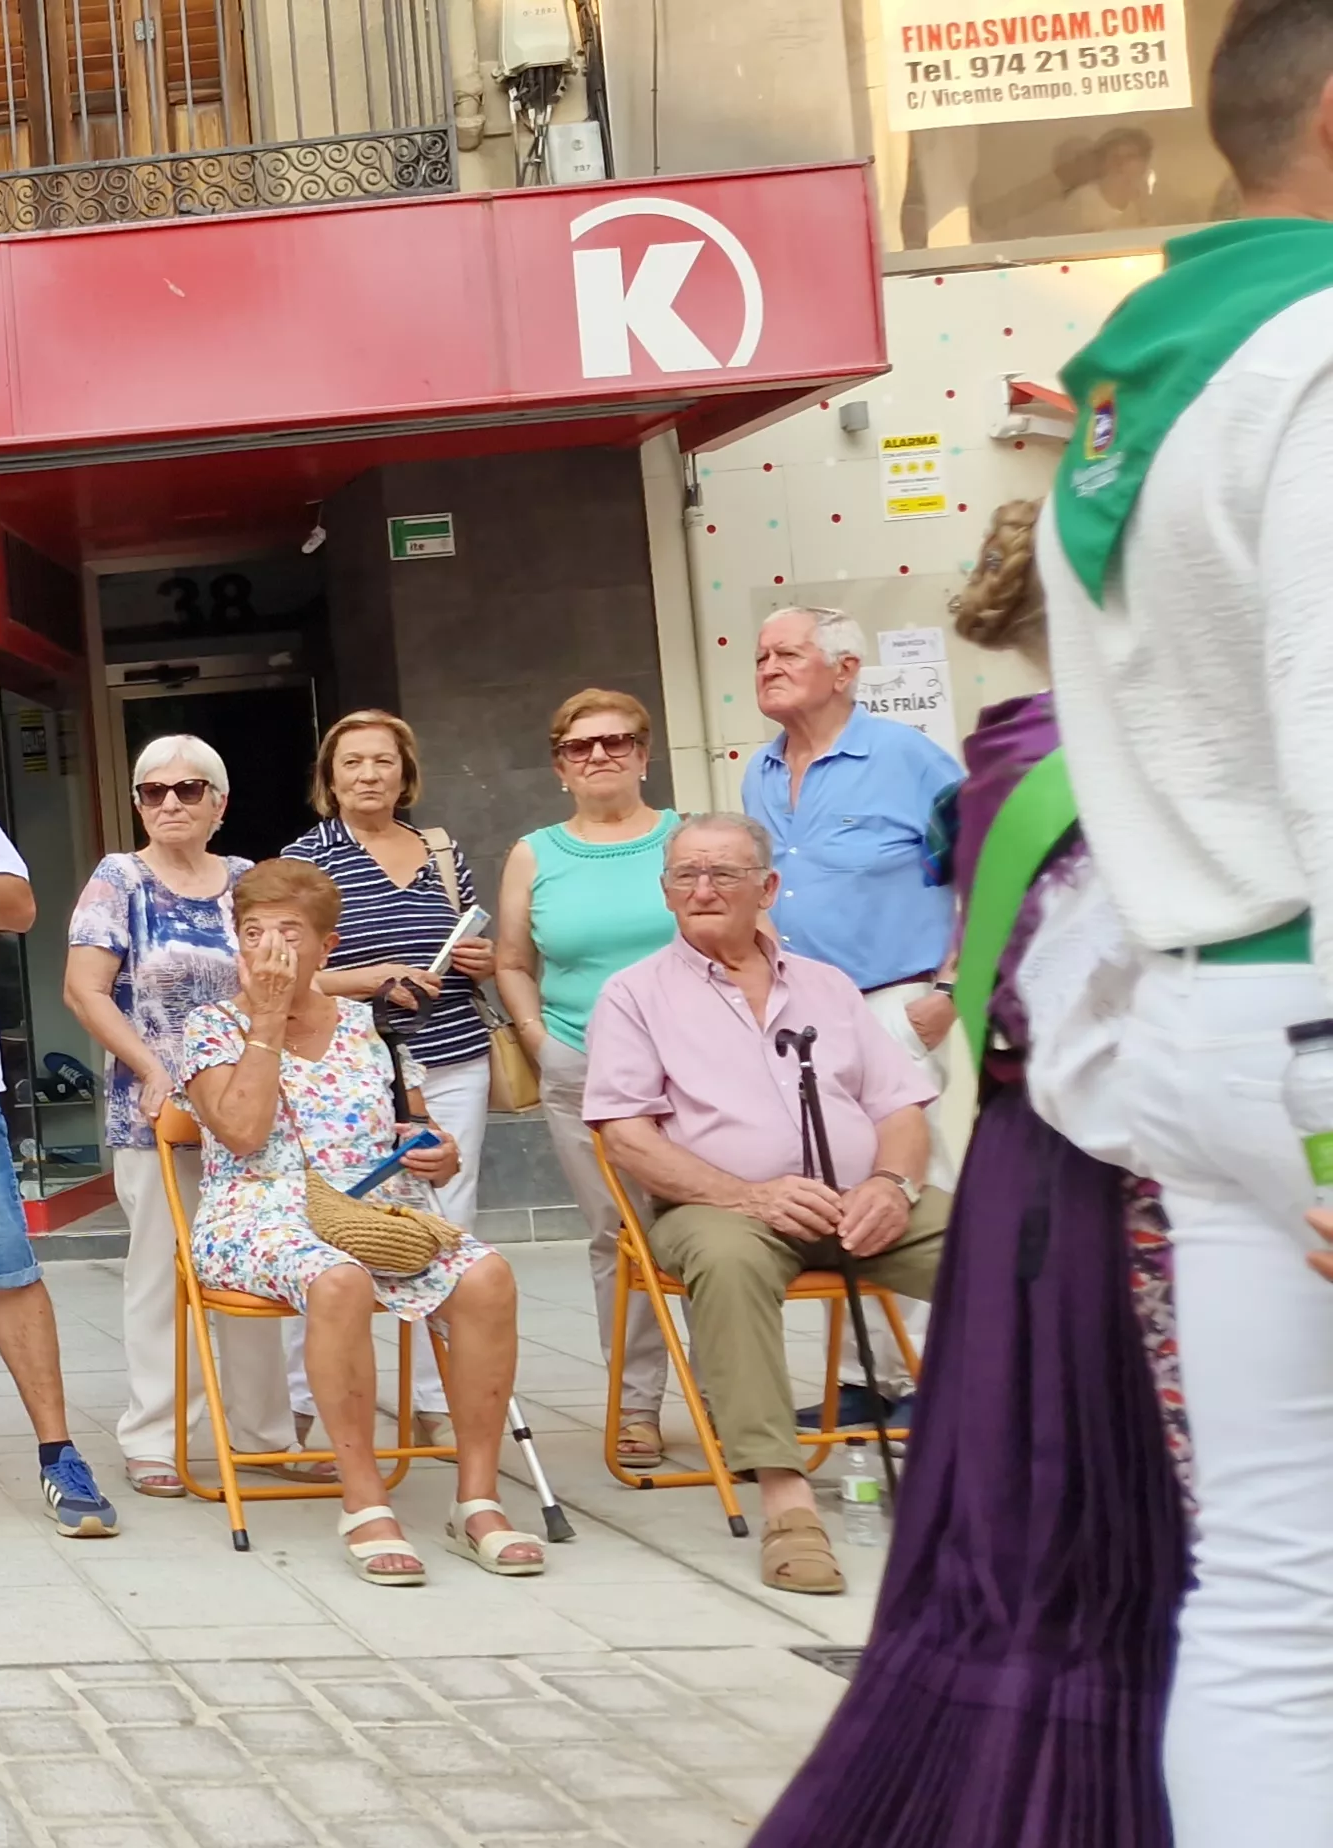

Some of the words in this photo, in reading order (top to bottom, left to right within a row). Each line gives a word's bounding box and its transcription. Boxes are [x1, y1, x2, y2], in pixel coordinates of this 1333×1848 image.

[901, 3, 1166, 53] FINCASVICAM.COM
[905, 59, 961, 84] Tel.
[970, 52, 1026, 79] 974
[1035, 49, 1069, 73] 21
[1079, 44, 1120, 69] 53
[1130, 40, 1167, 65] 31
[932, 86, 1003, 107] Vicente
[1082, 76, 1092, 95] 9
[1098, 69, 1169, 94] HUESCA
[884, 436, 938, 448] ALARMA
[157, 573, 257, 635] 38
[893, 693, 937, 712] FRÍAS
